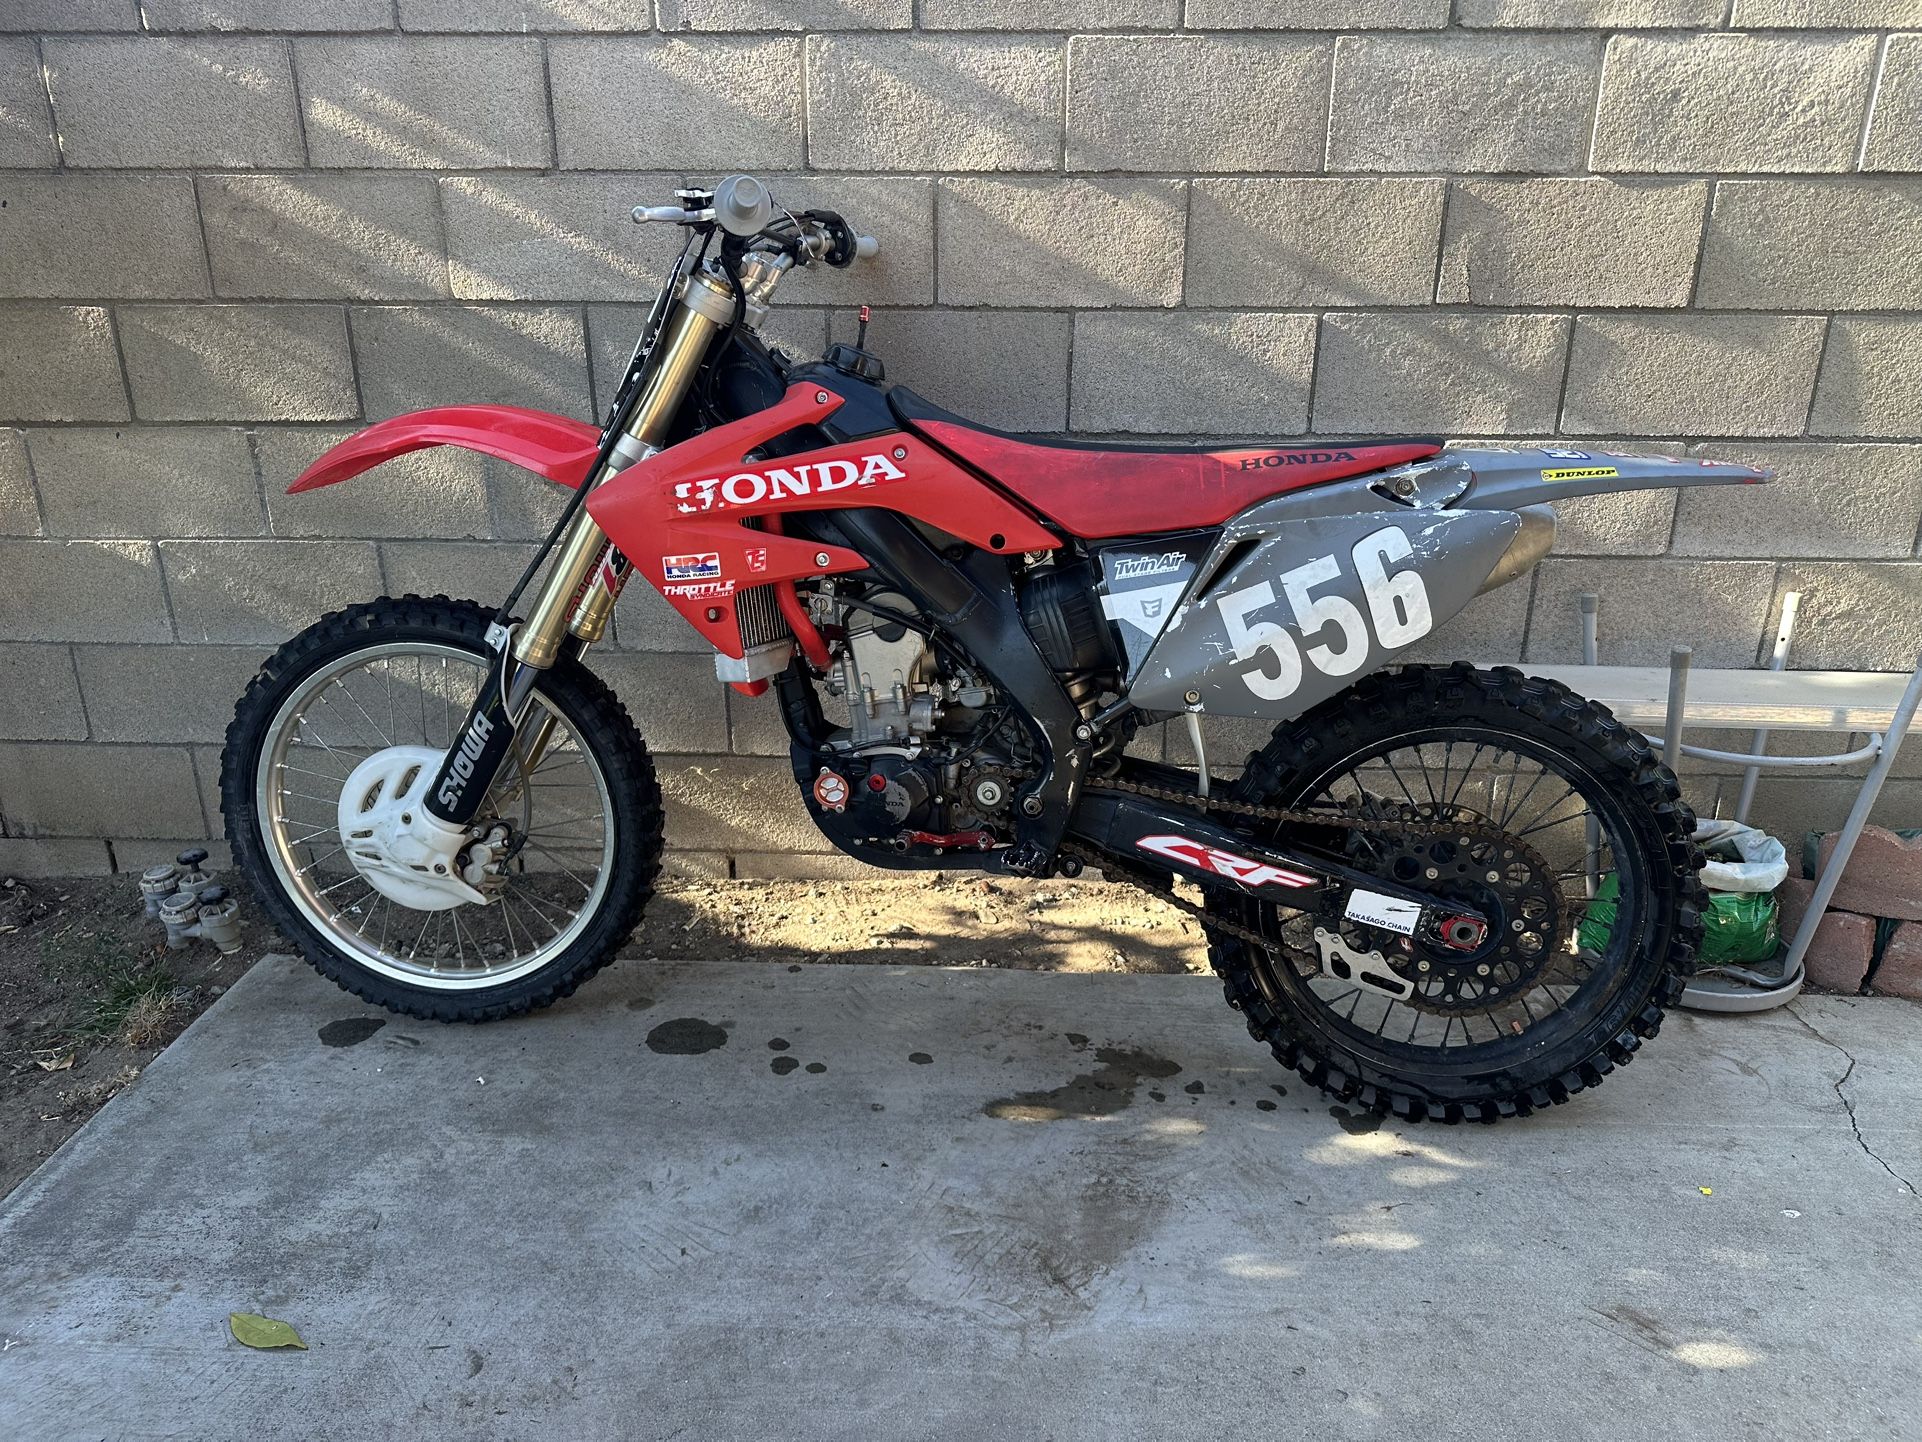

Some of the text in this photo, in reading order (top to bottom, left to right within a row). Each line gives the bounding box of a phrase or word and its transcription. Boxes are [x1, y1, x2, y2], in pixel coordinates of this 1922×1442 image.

[1240, 452, 1357, 471] HONDA
[1554, 469, 1616, 478] DUNLOP
[665, 554, 719, 575] HRC
[1114, 556, 1157, 579] Twin
[1157, 552, 1186, 572] Air
[663, 579, 736, 597] THROTTLE
[1216, 525, 1433, 700] 556
[437, 710, 494, 812] SHOWA
[1136, 834, 1319, 887] CRF
[1347, 911, 1411, 933] TAKASAGO CHAIN
